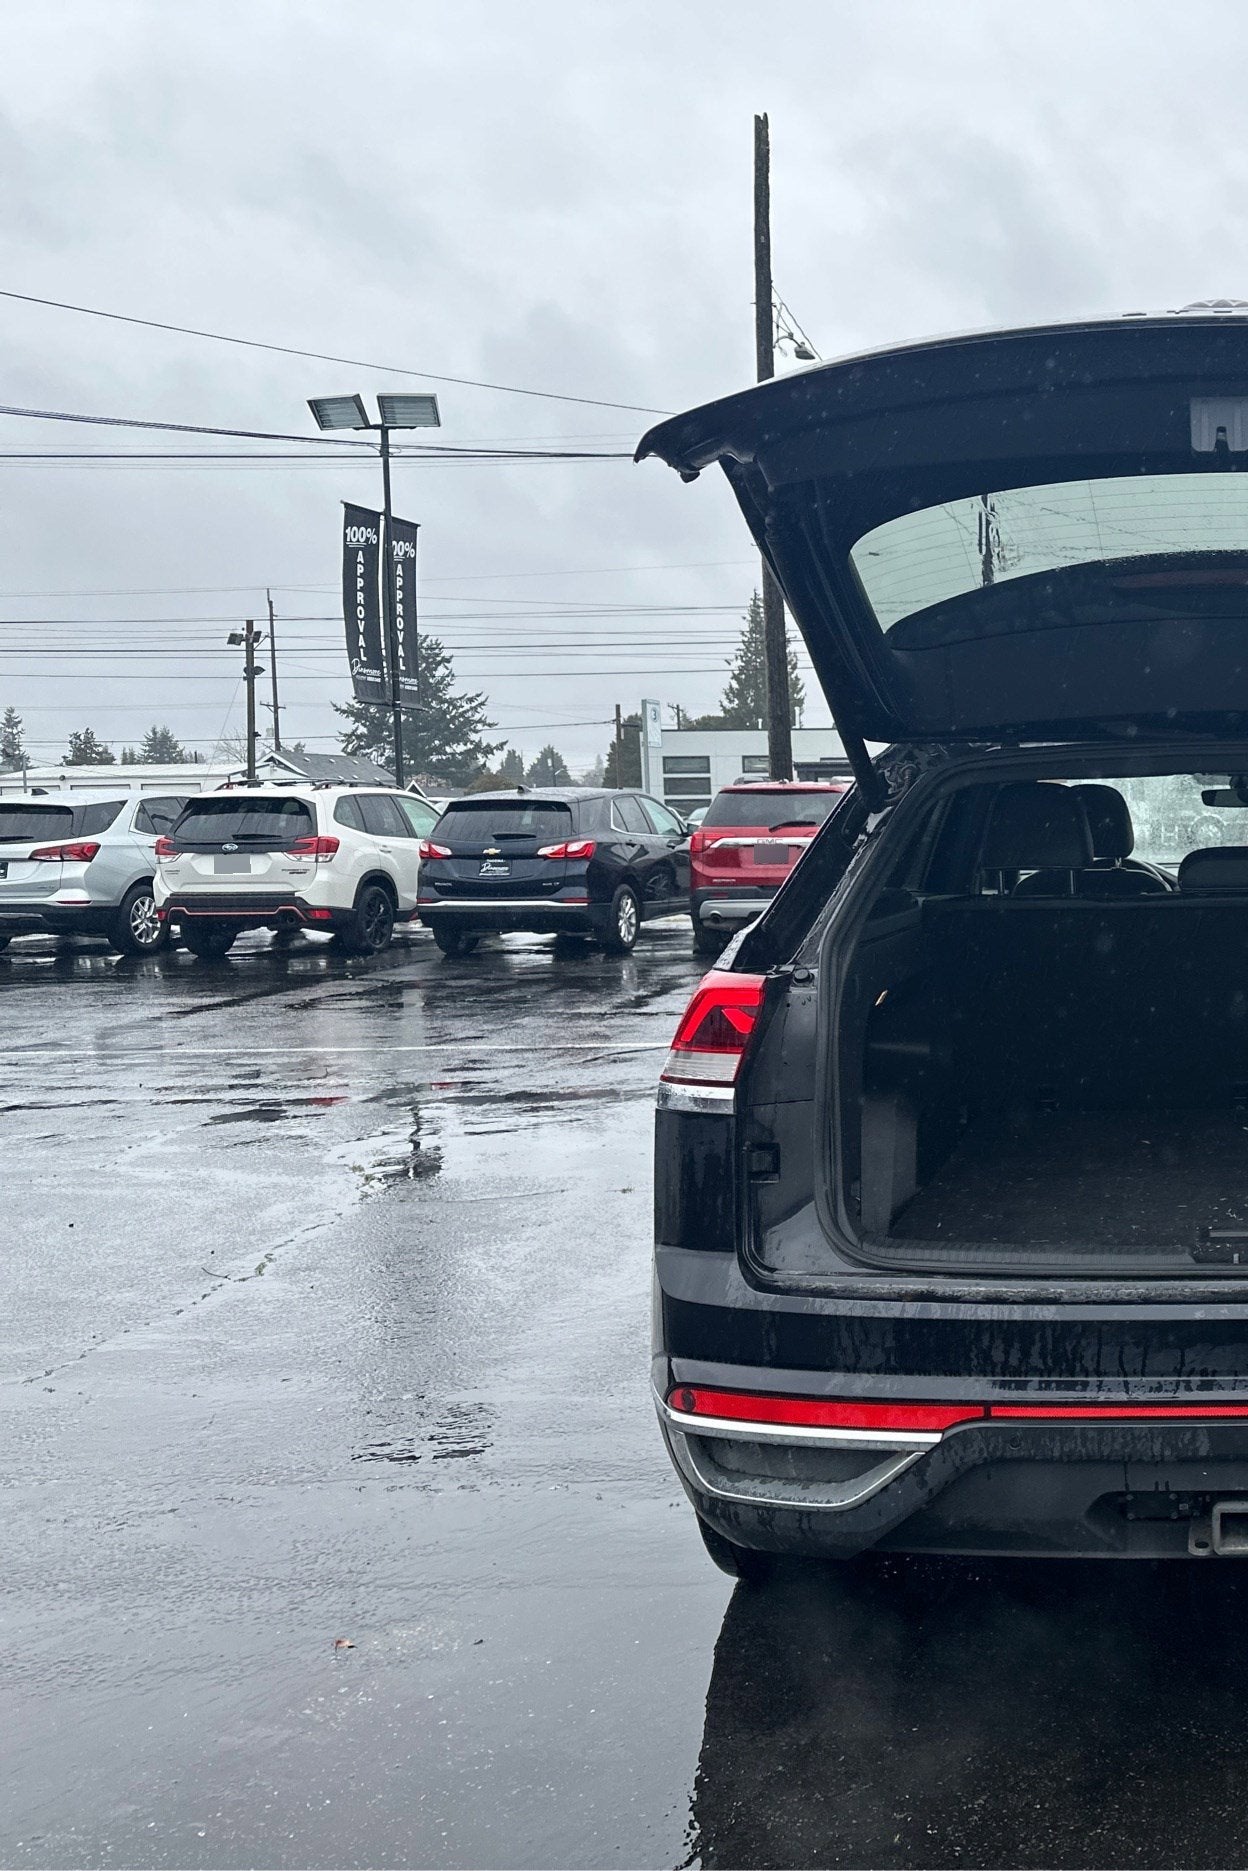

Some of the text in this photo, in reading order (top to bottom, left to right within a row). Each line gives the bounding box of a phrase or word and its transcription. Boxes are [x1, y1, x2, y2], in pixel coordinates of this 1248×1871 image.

[345, 526, 378, 545] 100%
[391, 540, 416, 558] 00%
[356, 550, 368, 662] APPROVAL
[396, 563, 406, 671] APPROVAL
